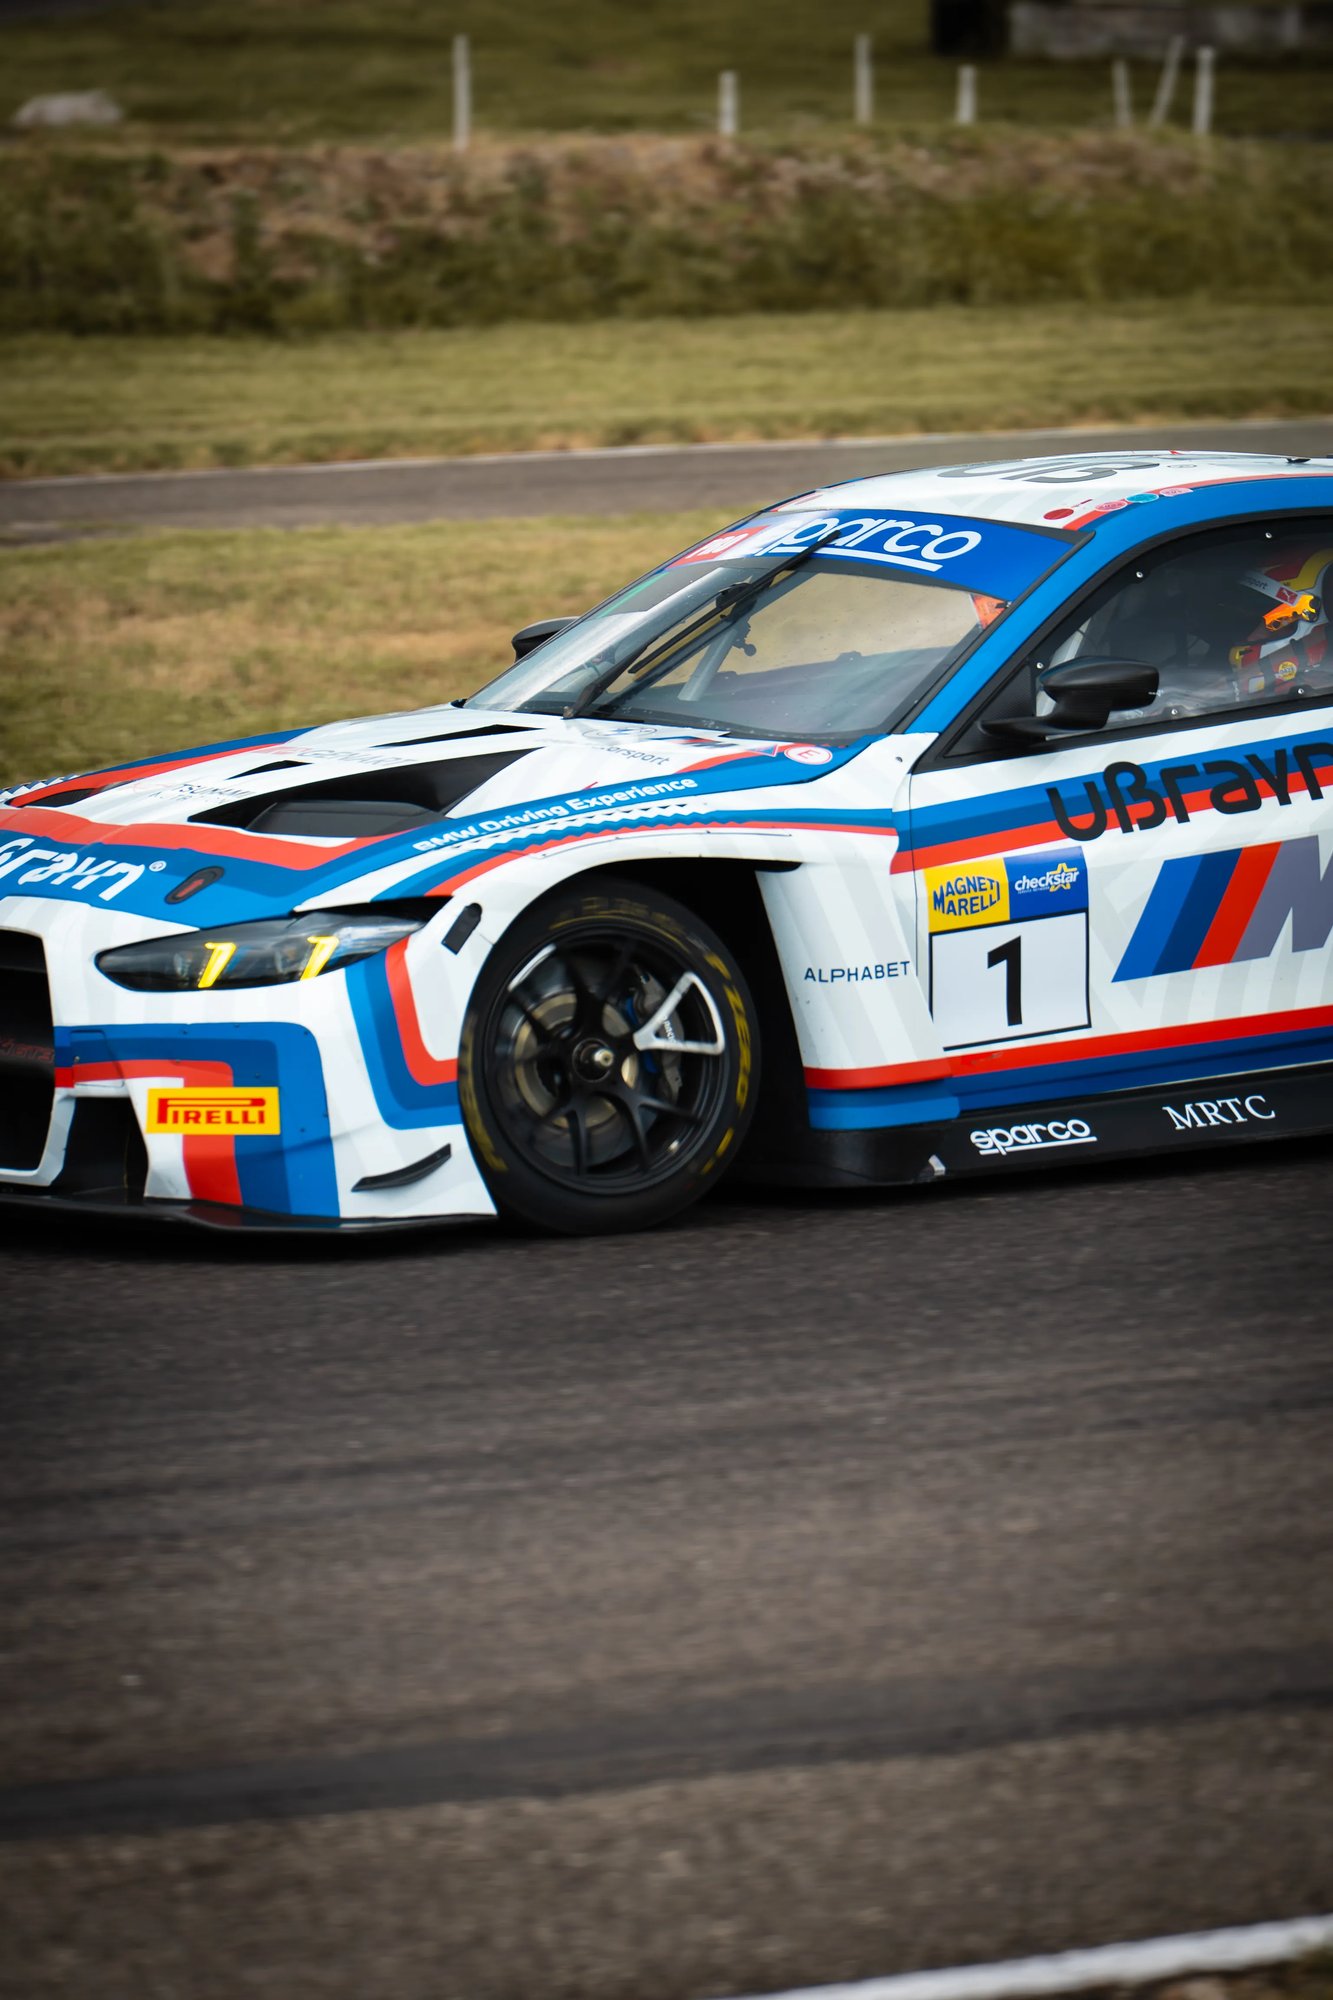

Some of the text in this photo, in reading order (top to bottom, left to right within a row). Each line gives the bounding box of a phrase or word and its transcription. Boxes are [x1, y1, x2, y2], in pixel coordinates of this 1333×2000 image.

[412, 778, 698, 852] BMW Driving Experience
[933, 876, 1001, 905] MAGNETI
[1014, 866, 1080, 892] checkstar
[933, 888, 1001, 916] MARELLI
[804, 960, 910, 983] ALPHABET
[987, 935, 1023, 1027] 1
[156, 1098, 266, 1124] PIRELLI
[1162, 1095, 1276, 1131] MRTC
[970, 1119, 1094, 1155] sparco
